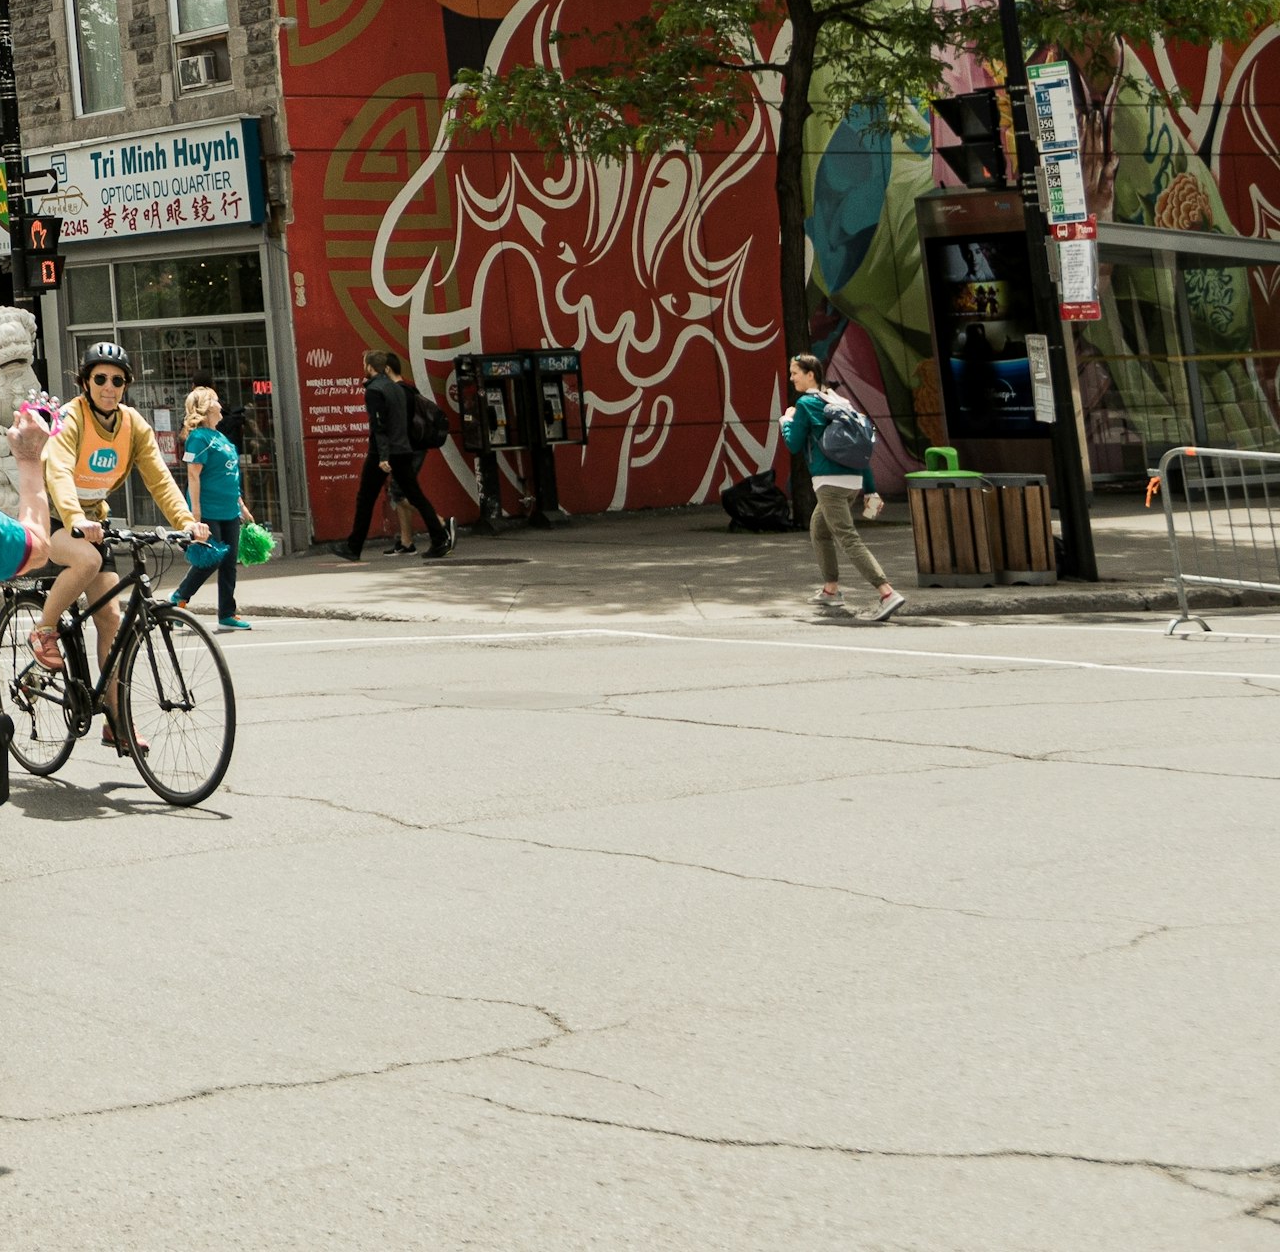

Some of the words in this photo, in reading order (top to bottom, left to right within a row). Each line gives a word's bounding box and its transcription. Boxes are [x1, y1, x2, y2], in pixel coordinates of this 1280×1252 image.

[1040, 118, 1053, 129] 350
[1042, 132, 1055, 142] 355
[91, 150, 114, 180] Tri
[121, 142, 167, 176] Minh
[174, 131, 239, 172] Huynh
[1046, 164, 1059, 175] 358
[1048, 177, 1061, 187] 364
[101, 184, 150, 205] OPTICIEN
[154, 180, 169, 198] DU
[171, 171, 232, 197] QUARTIER
[92, 450, 116, 468] lait
